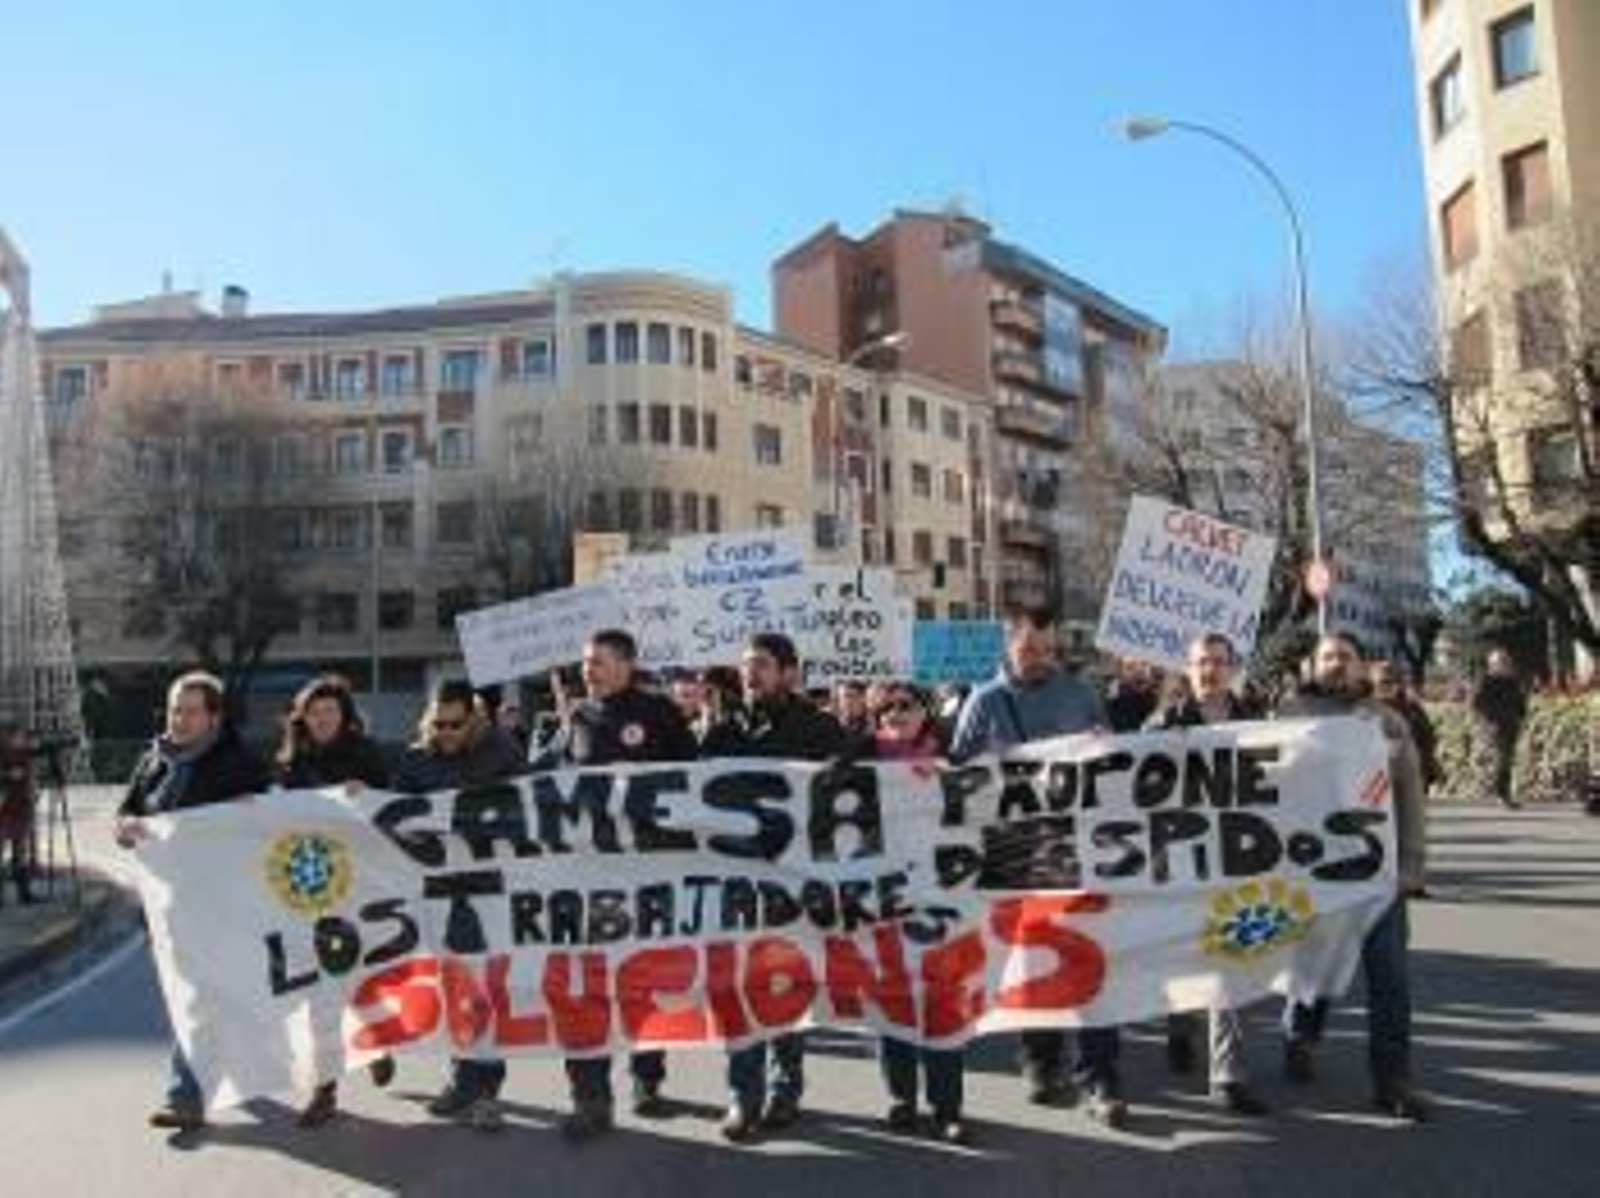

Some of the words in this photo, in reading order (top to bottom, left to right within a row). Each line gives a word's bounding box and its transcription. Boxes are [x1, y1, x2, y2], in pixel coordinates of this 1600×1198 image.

[373, 761, 884, 866] GAMESA
[264, 898, 419, 995] LOS
[423, 868, 960, 953] TRABAJADORES
[348, 893, 1109, 1050] SOLUCIONES
